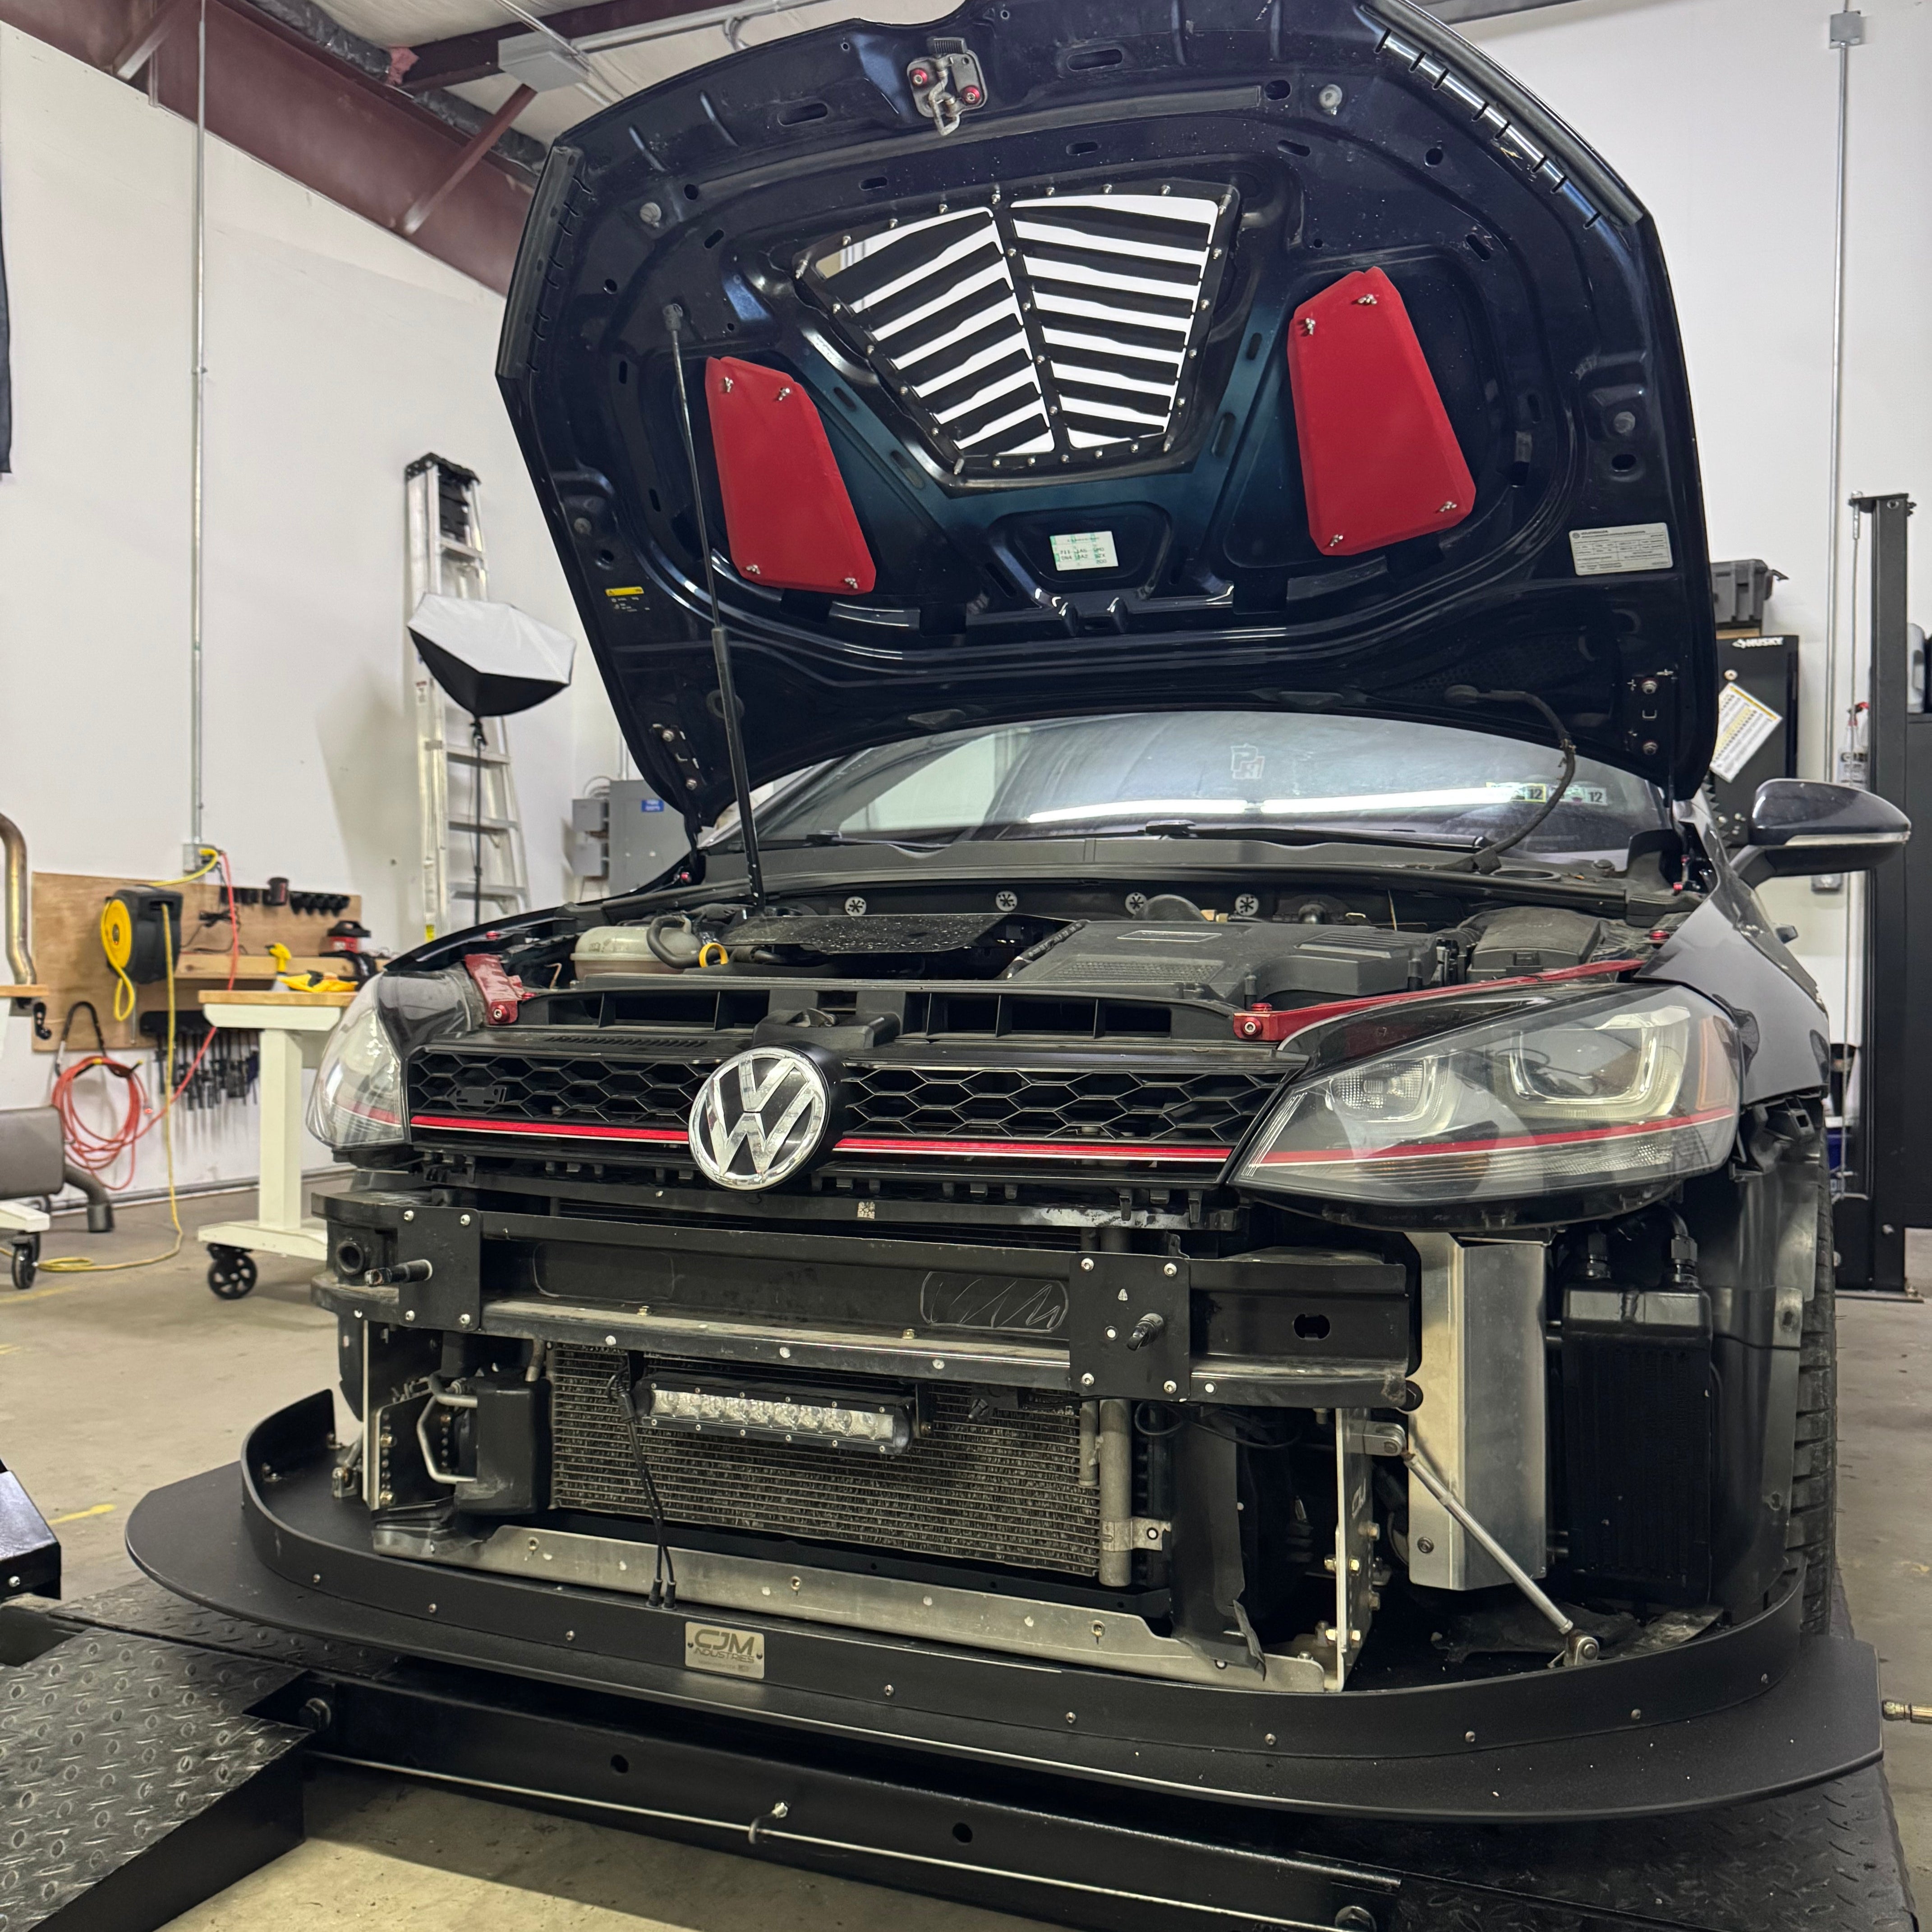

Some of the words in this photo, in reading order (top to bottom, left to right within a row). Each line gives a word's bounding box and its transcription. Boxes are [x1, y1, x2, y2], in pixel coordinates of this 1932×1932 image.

[1528, 788, 1544, 799] 12
[1588, 791, 1603, 803] 12
[694, 1628, 755, 1656] CJM
